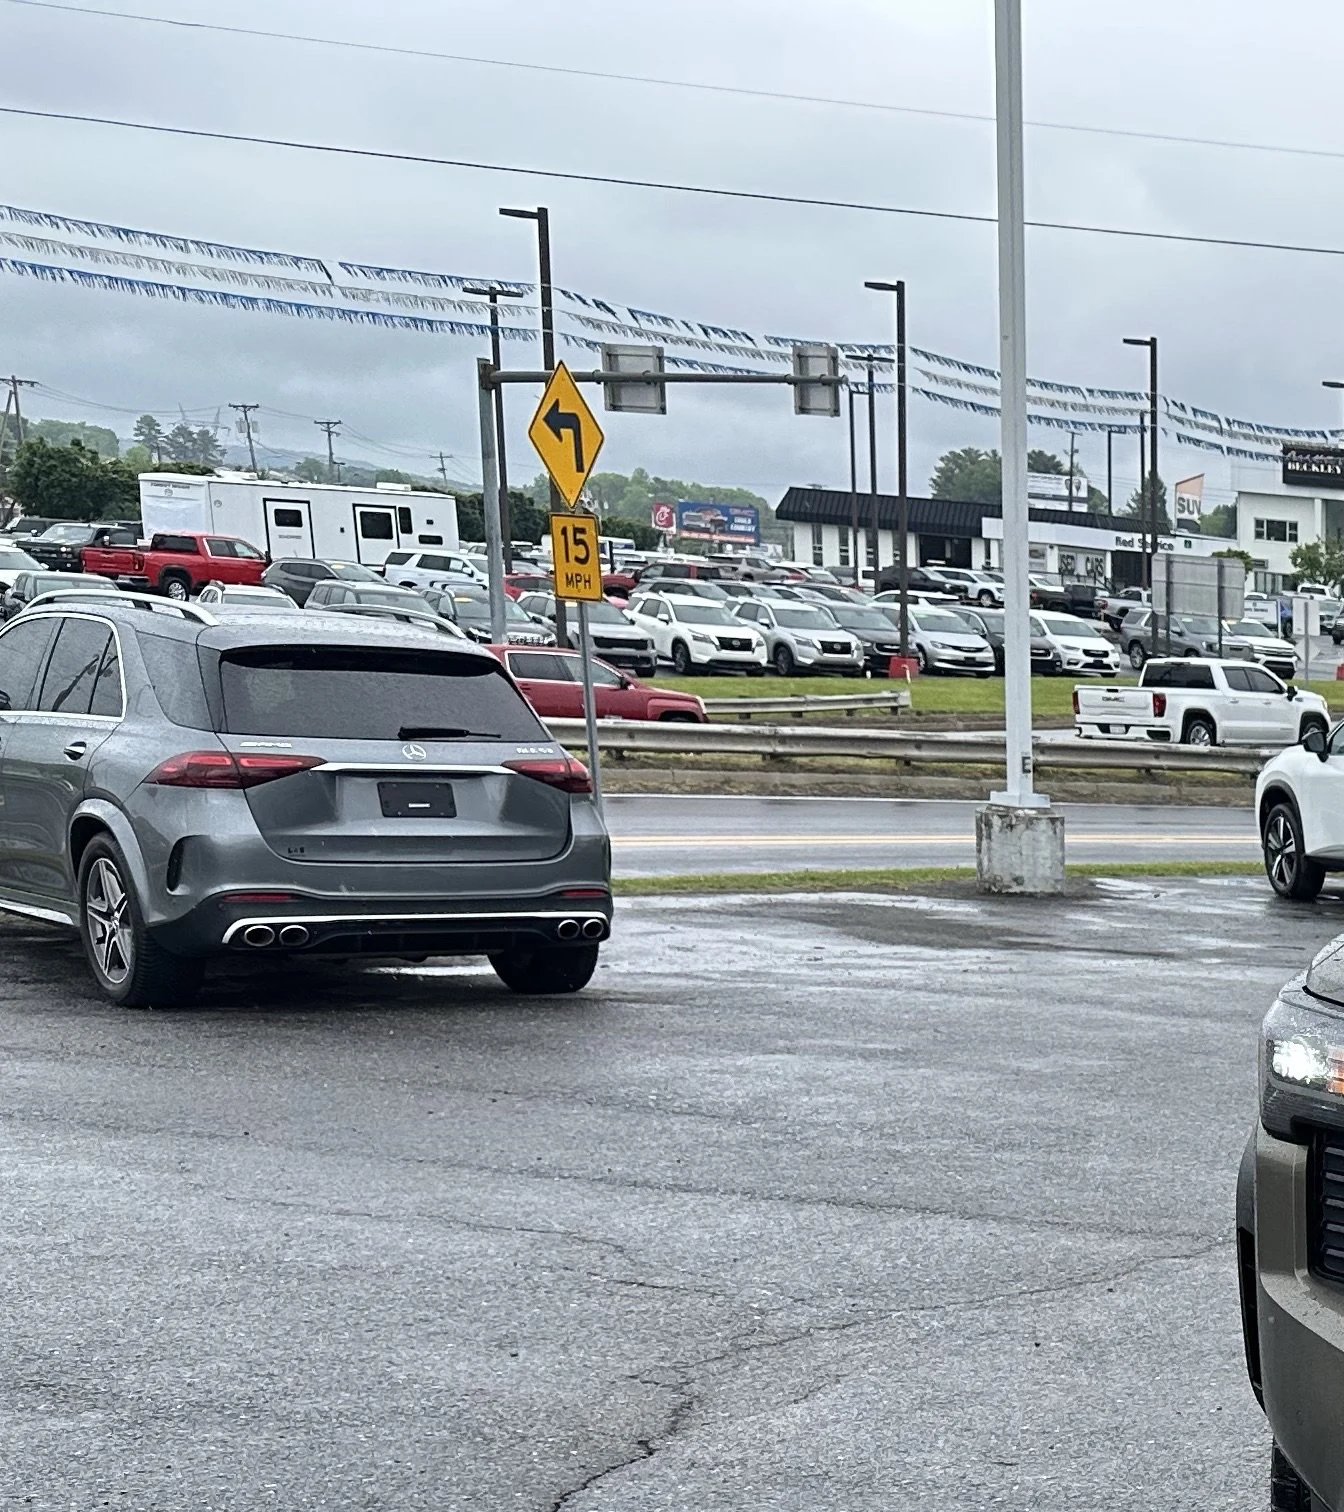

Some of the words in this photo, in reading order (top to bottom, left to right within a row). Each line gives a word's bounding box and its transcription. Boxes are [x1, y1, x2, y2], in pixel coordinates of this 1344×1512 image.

[1287, 462, 1341, 475] BECKLEY
[1177, 496, 1201, 515] SUV
[561, 525, 590, 565] 15
[1137, 538, 1174, 551] Sevice
[565, 572, 592, 590] MPH
